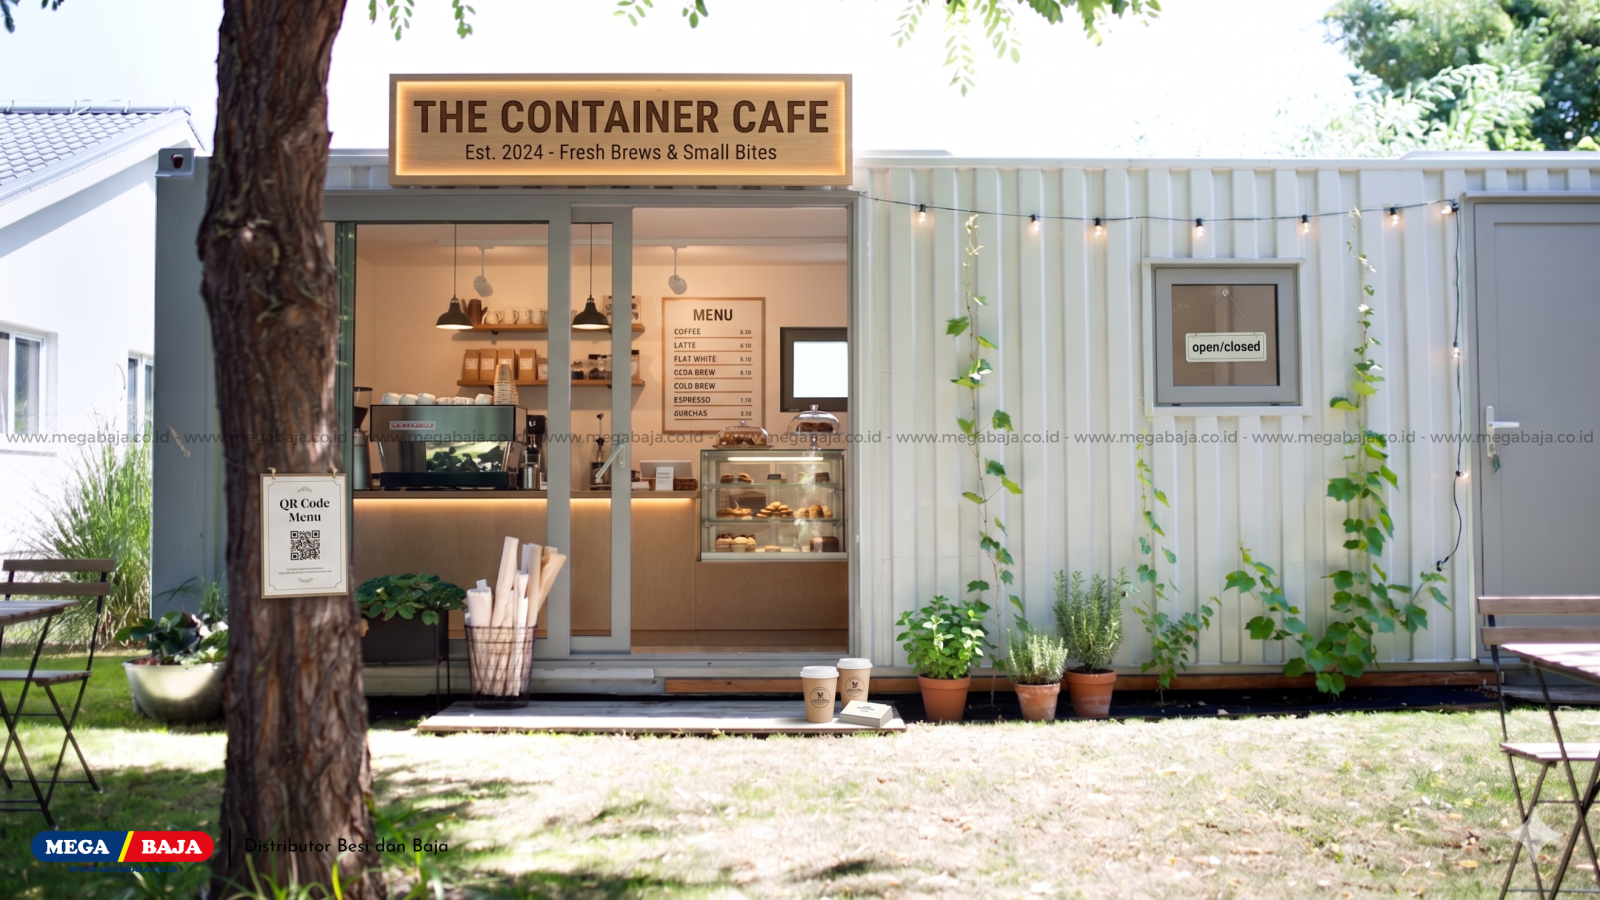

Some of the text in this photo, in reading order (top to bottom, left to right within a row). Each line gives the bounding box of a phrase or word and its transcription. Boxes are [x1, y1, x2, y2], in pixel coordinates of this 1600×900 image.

[413, 100, 829, 134] THE CONTAINER CAFE
[465, 143, 496, 160] Est.
[502, 143, 544, 160] 2024
[560, 143, 605, 160] Fresh
[611, 143, 662, 160] Brews
[667, 143, 678, 160] &
[683, 143, 730, 160] Small
[735, 143, 777, 160] Bites
[693, 308, 733, 322] MENU
[674, 341, 697, 349] LATTE
[1192, 340, 1261, 355] open/closed
[674, 382, 716, 390] COLD BREW
[674, 396, 711, 404] ESPRESSO
[279, 498, 330, 511] QR Code
[289, 512, 322, 522] Menu
